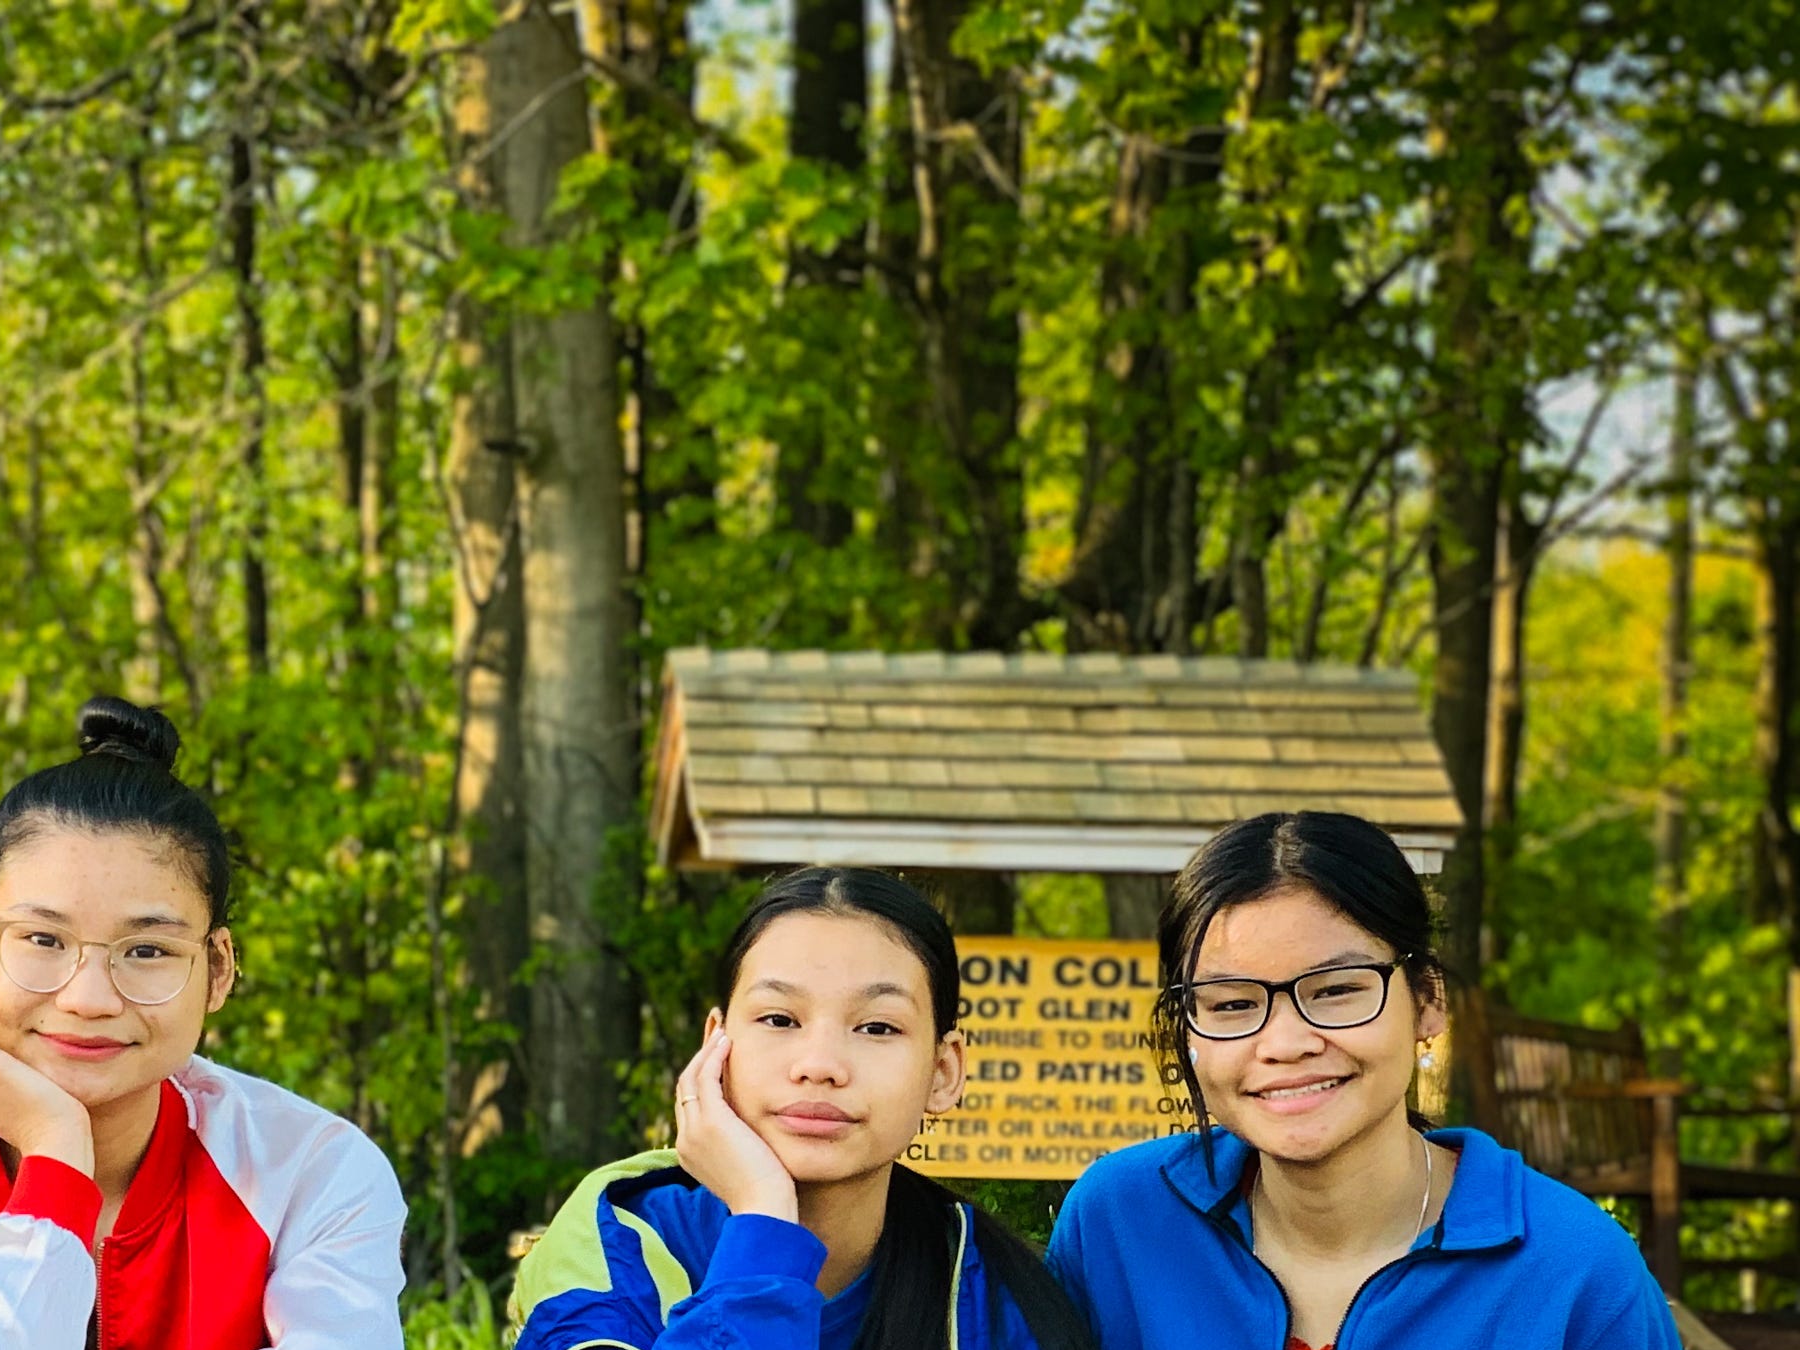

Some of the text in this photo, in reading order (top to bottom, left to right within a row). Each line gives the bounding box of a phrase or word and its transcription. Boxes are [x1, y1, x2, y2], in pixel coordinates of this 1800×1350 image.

[960, 956, 1152, 988] ON COL
[1039, 998, 1131, 1021] GLEN
[961, 1028, 1043, 1049] NRISE
[1054, 1030, 1091, 1049] TO
[1038, 1062, 1145, 1084] PATHS
[1006, 1094, 1060, 1112] PICK
[1073, 1095, 1117, 1113] THE
[999, 1120, 1033, 1137] OR
[1043, 1121, 1158, 1139] UNLEASH
[899, 1144, 968, 1162] CLES
[978, 1145, 1012, 1162] OR
